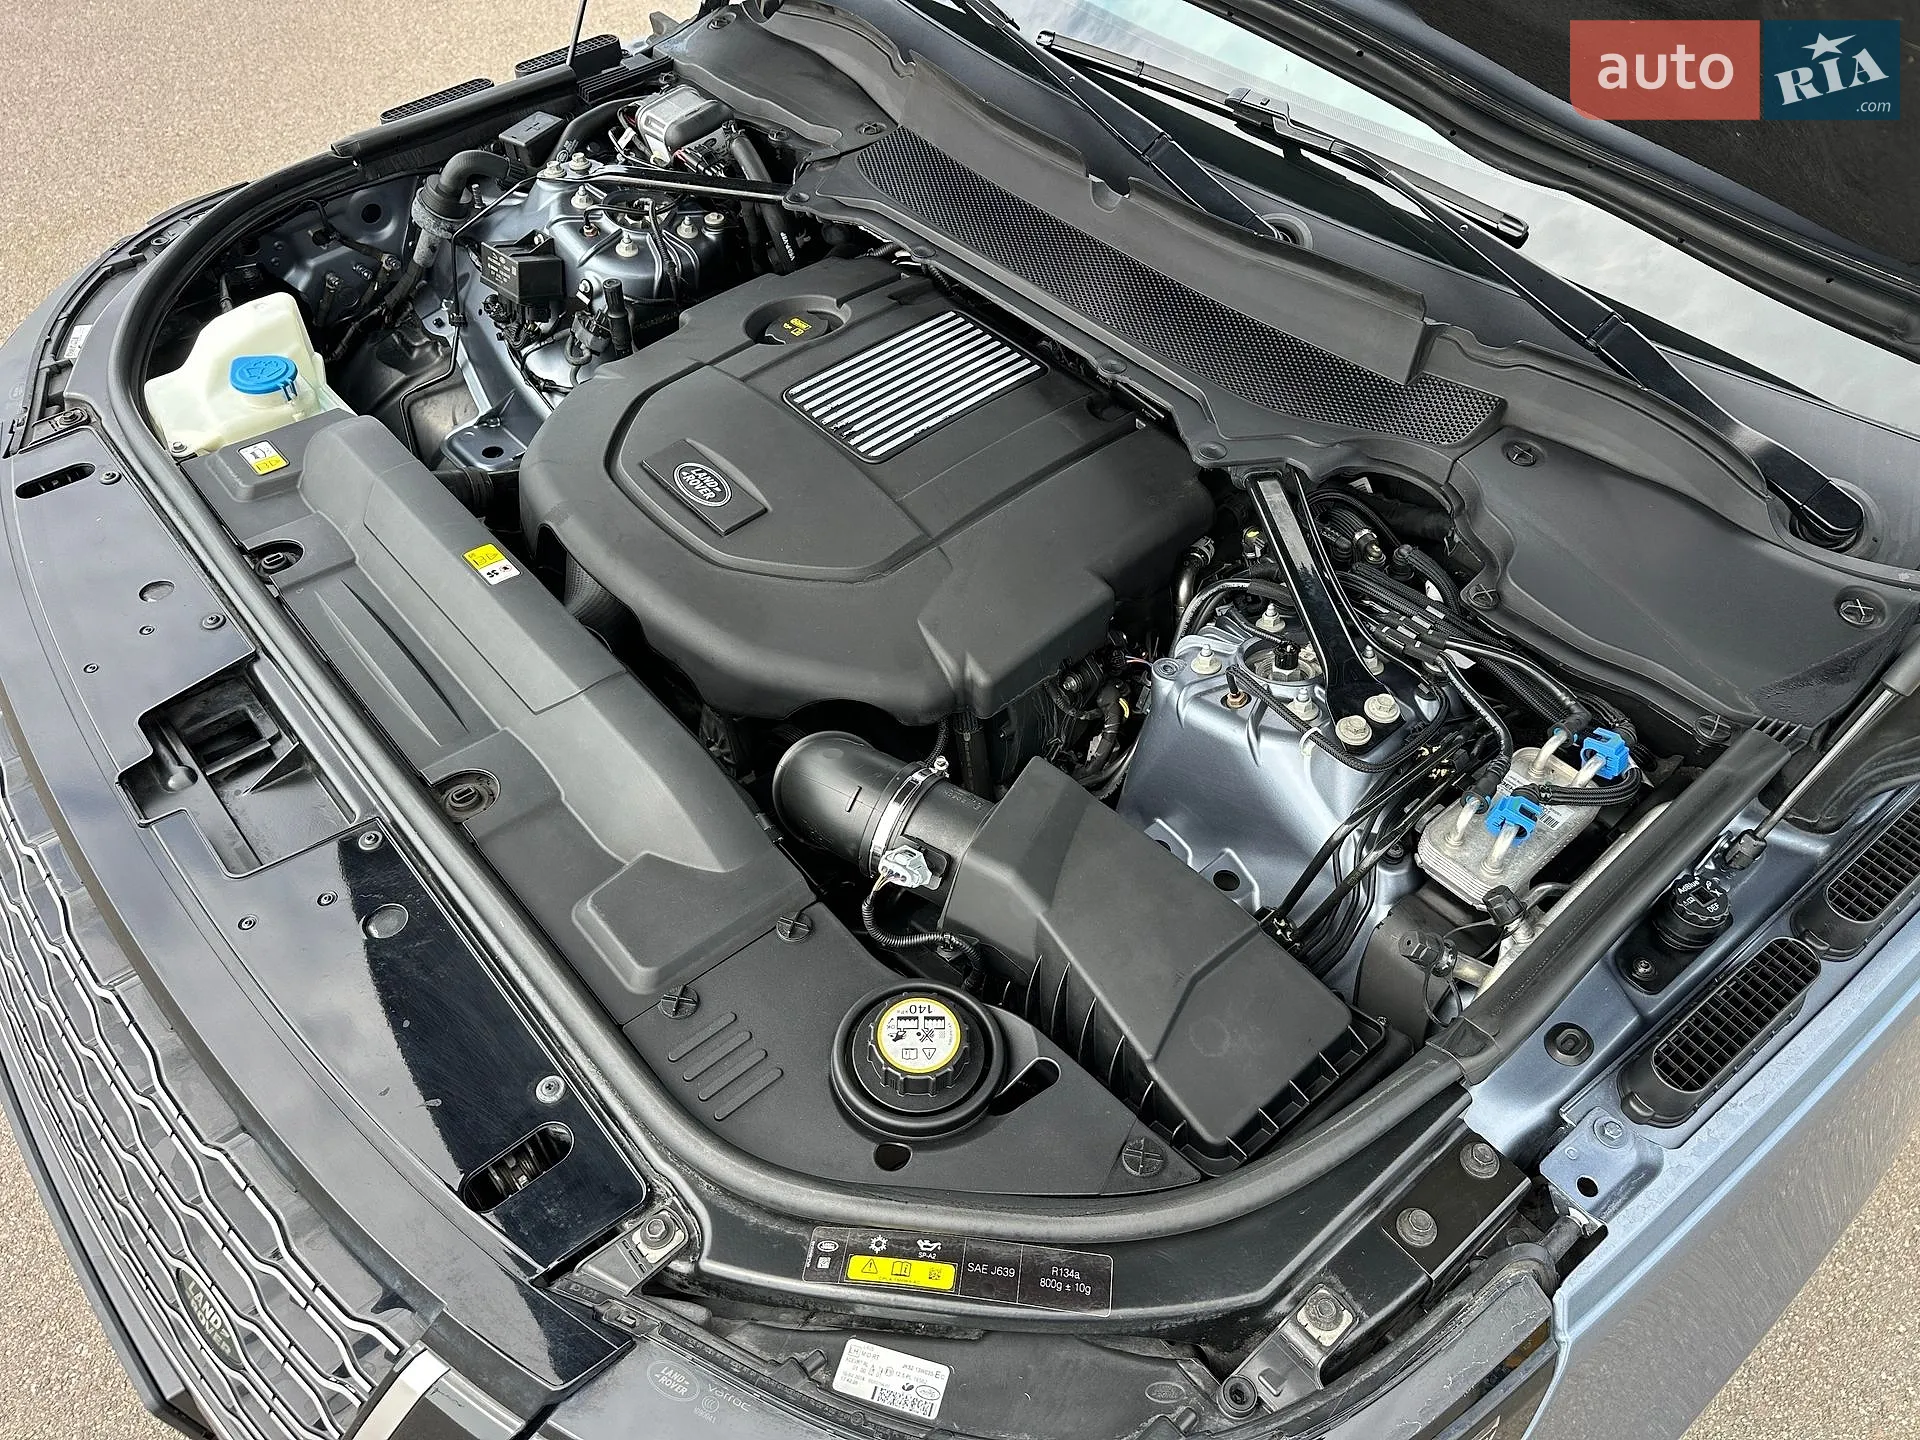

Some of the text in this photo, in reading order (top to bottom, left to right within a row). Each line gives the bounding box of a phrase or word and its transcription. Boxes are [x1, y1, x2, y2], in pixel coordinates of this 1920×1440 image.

[682, 474, 716, 500] ROVER
[691, 468, 719, 488] LAND
[1706, 902, 1720, 913] DEF
[909, 1004, 933, 1014] 140
[918, 1251, 937, 1260] SP-A2
[967, 1262, 1016, 1278] SAE J639
[1051, 1266, 1081, 1280] R134a
[1039, 1277, 1063, 1292] 800g
[1074, 1282, 1092, 1296] 10g
[188, 1280, 222, 1330] LAND
[190, 1298, 231, 1356] ROVER
[660, 1366, 686, 1383] LAND
[658, 1375, 688, 1396] ROVER
